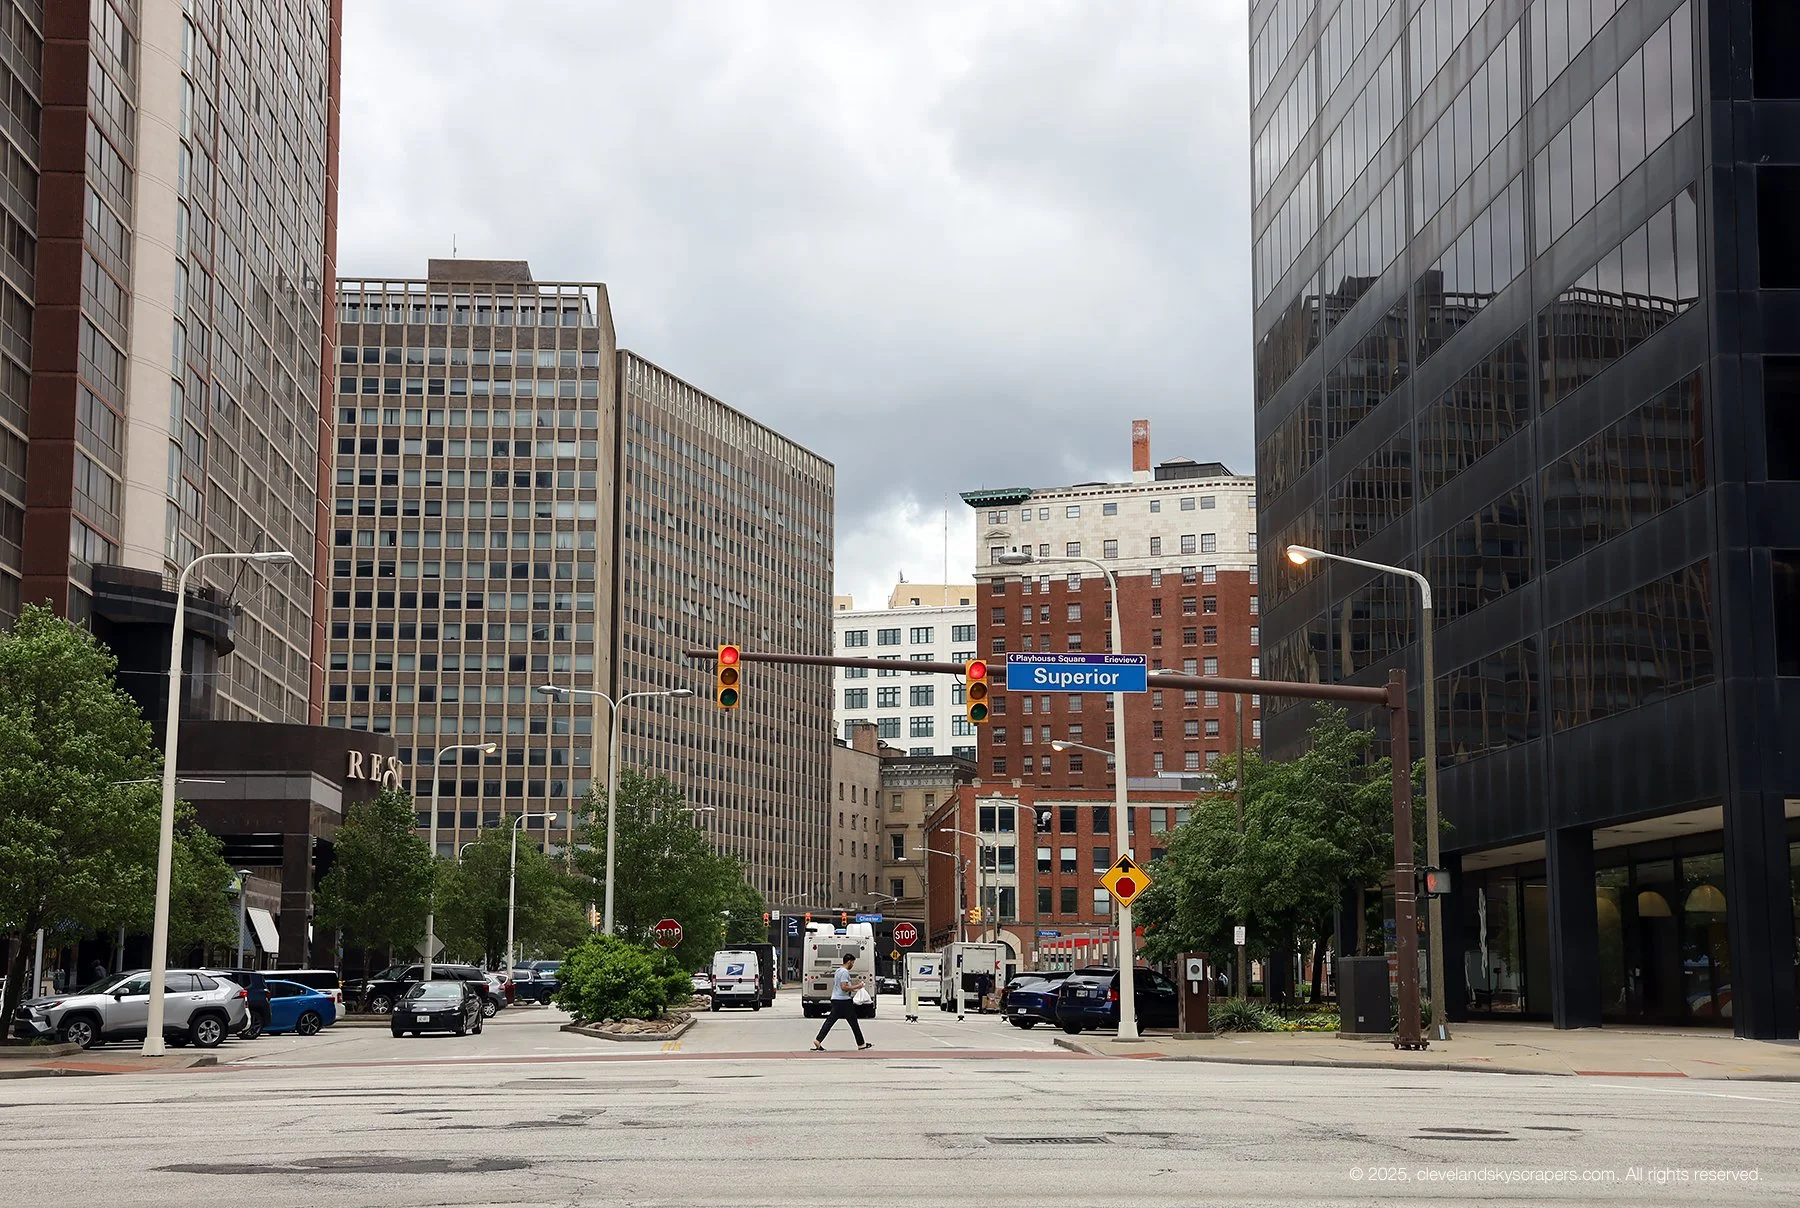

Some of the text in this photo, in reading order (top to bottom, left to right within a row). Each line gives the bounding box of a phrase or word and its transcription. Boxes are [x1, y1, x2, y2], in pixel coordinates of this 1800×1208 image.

[1016, 655, 1086, 663] Playhouse Square
[1104, 656, 1138, 664] Erieview
[1034, 667, 1119, 687] Superior
[895, 930, 915, 939] STOP
